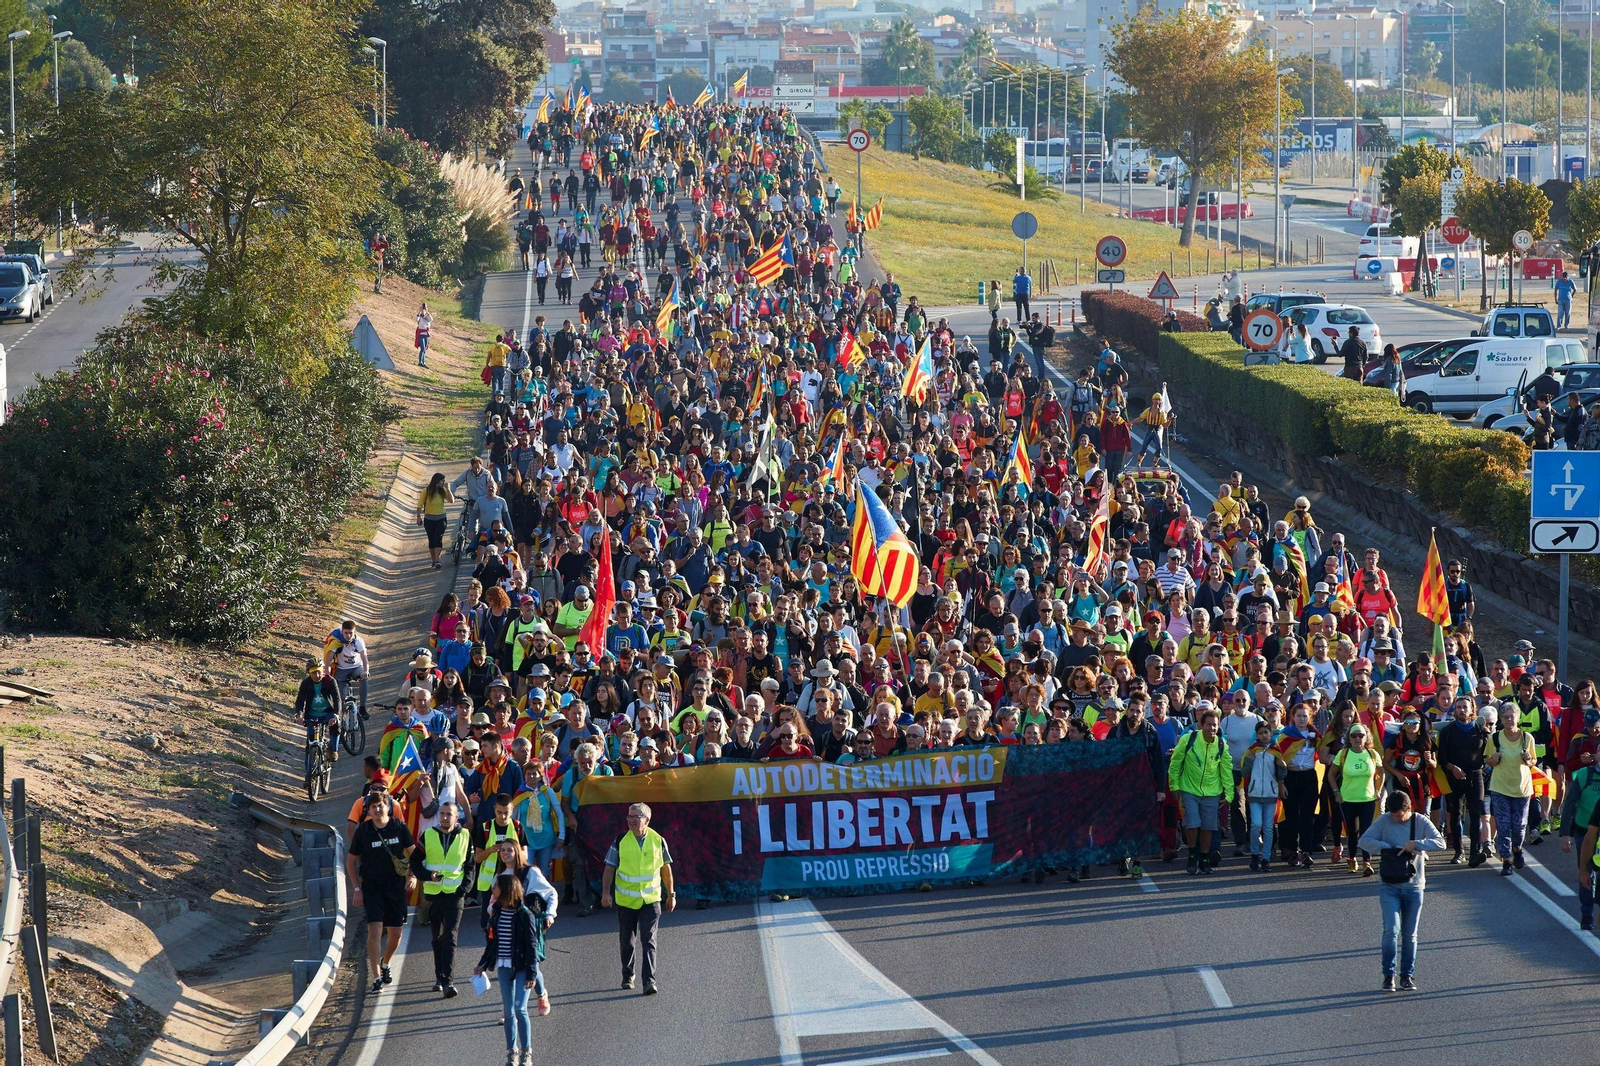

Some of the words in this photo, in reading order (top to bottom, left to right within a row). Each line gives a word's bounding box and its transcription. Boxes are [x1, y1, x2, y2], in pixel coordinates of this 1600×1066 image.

[757, 88, 773, 96] CE
[853, 136, 866, 145] 70
[1517, 236, 1529, 244] 30
[1101, 246, 1121, 257] 40
[1252, 324, 1273, 337] 70
[732, 746, 995, 796] AUTODETERMINACIÓ
[757, 790, 995, 853] LLIBERTAT
[801, 859, 850, 882] PROU
[856, 847, 950, 879] REPRESSIÓ
